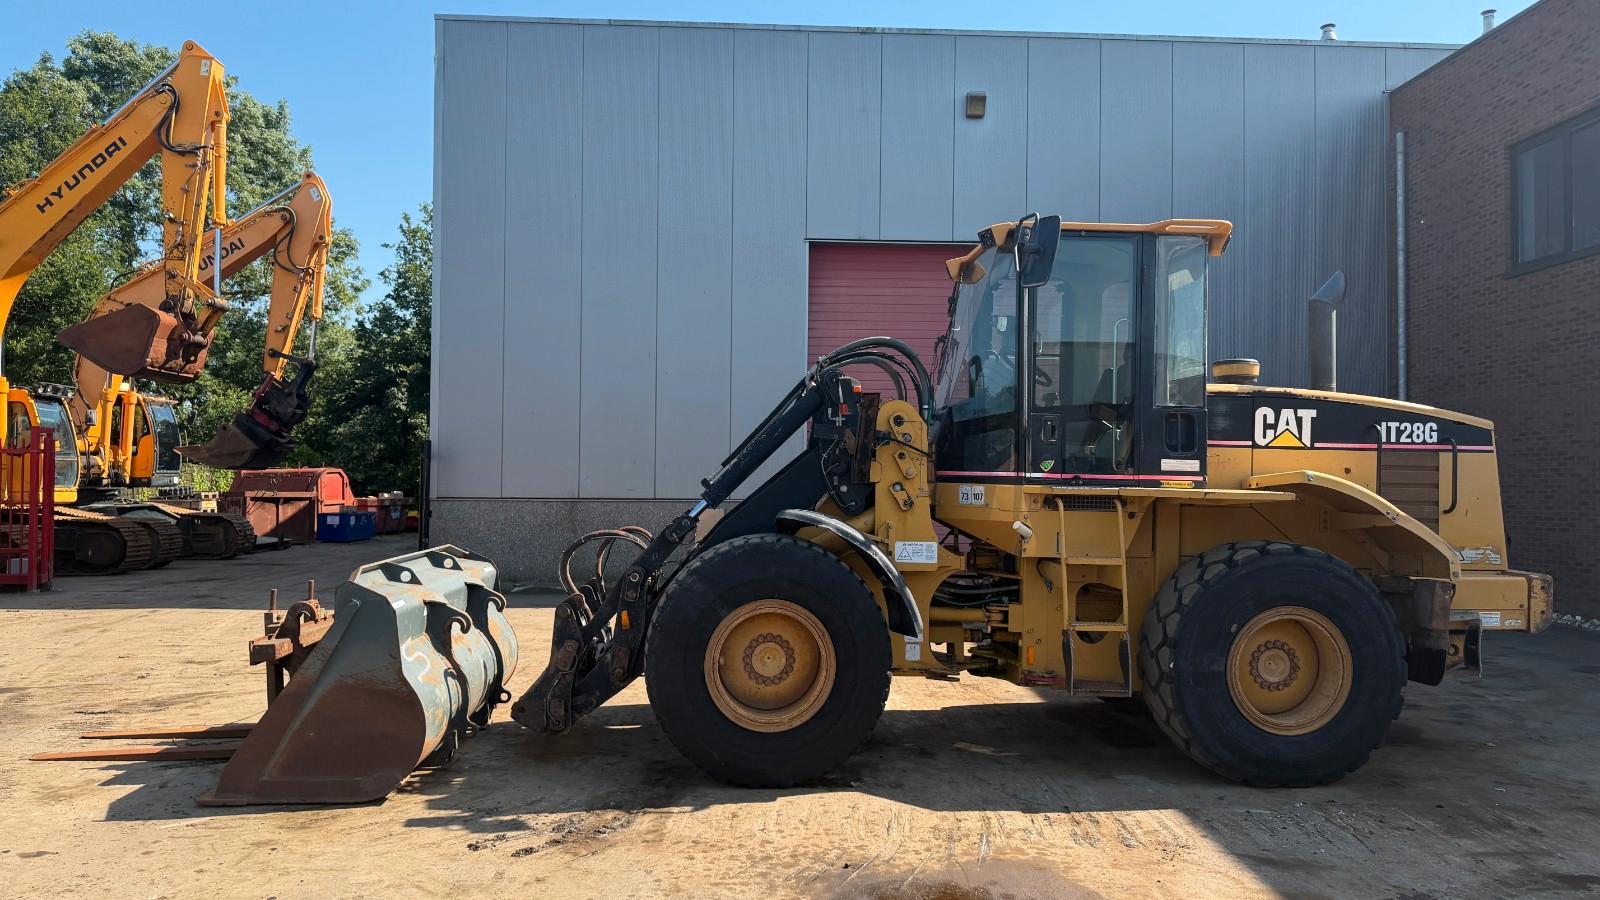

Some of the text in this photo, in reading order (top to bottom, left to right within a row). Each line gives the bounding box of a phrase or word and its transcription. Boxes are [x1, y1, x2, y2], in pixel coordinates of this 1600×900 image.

[36, 136, 128, 214] HYUNDAI
[199, 237, 245, 270] UNDAI
[1254, 406, 1317, 448] CAT
[1381, 421, 1438, 443] IT28G
[961, 492, 969, 501] 73
[973, 492, 984, 501] 107
